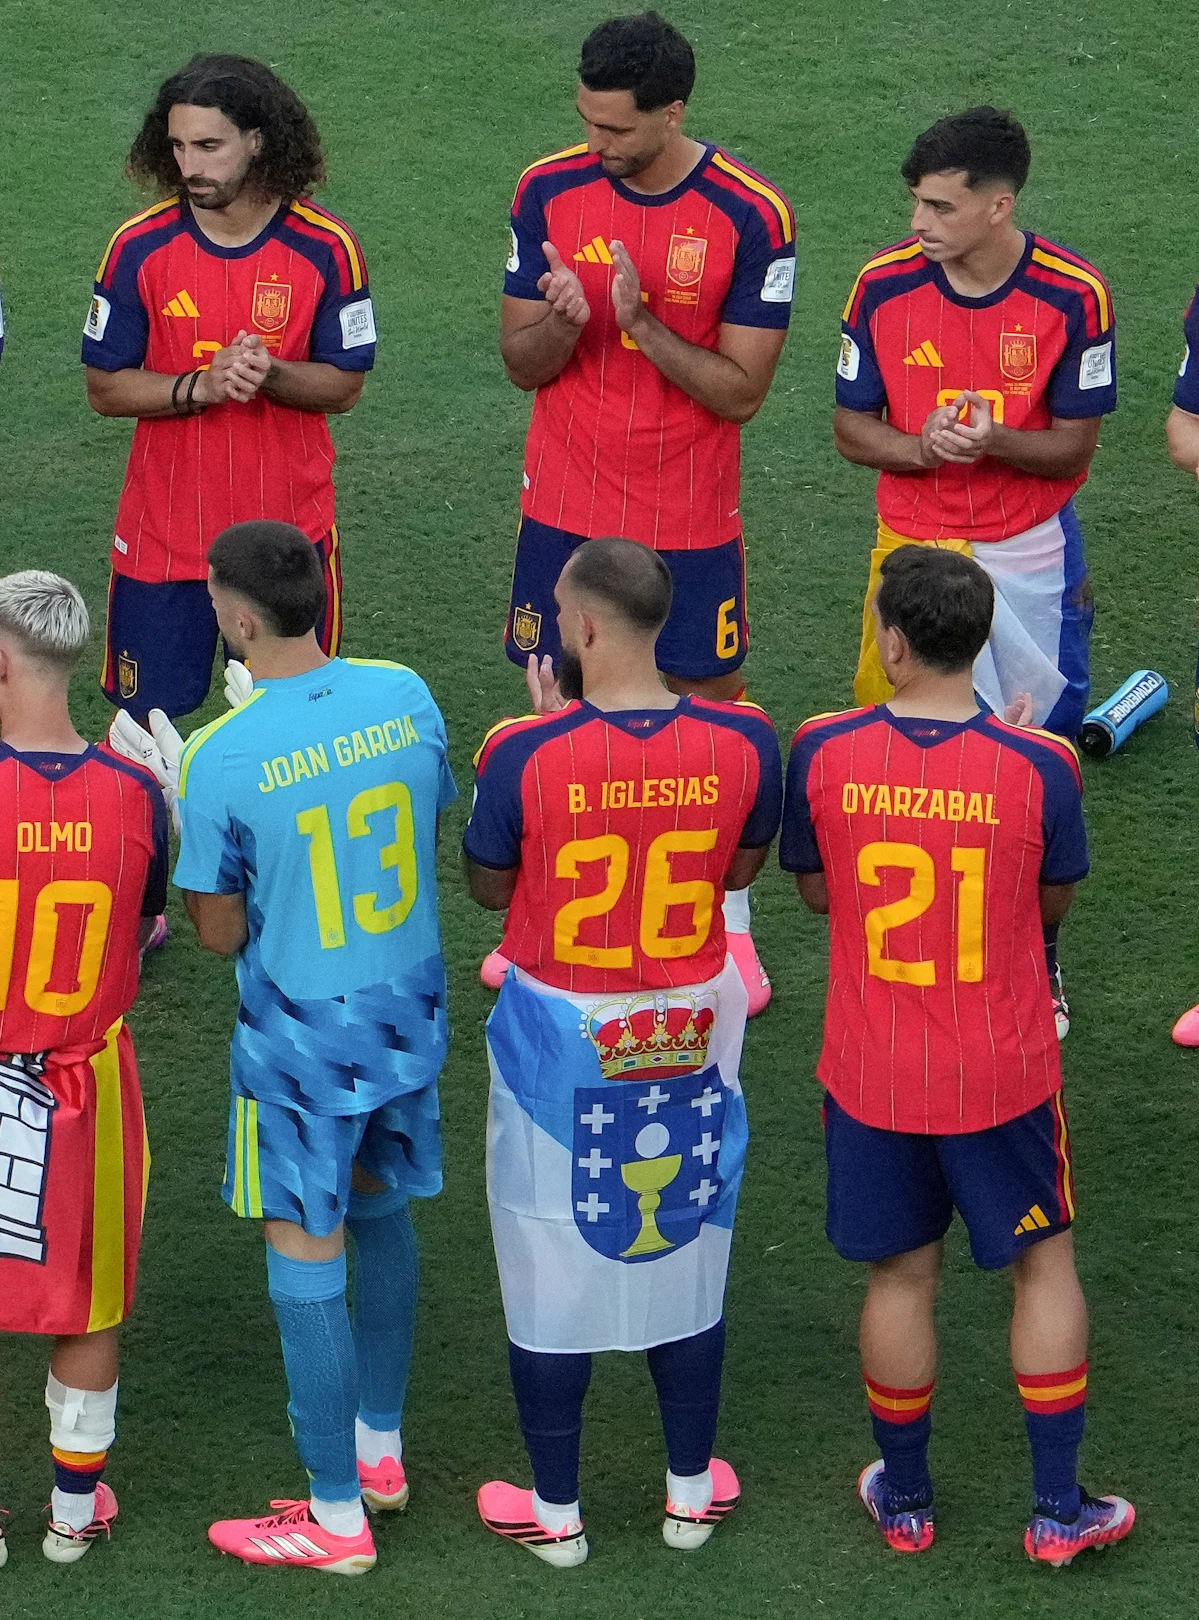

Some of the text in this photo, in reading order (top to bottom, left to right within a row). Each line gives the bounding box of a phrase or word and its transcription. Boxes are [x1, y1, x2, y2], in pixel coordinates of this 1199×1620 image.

[716, 596, 740, 660] 6
[1105, 675, 1158, 723] POWERADE
[258, 714, 422, 794] JOAN GARCIA
[567, 774, 720, 814] B. IGLESIAS
[842, 782, 1001, 825] OYARZABAL
[17, 821, 93, 853] OLMO
[295, 780, 420, 950] 13
[553, 827, 719, 969] 26
[856, 840, 986, 987] 21
